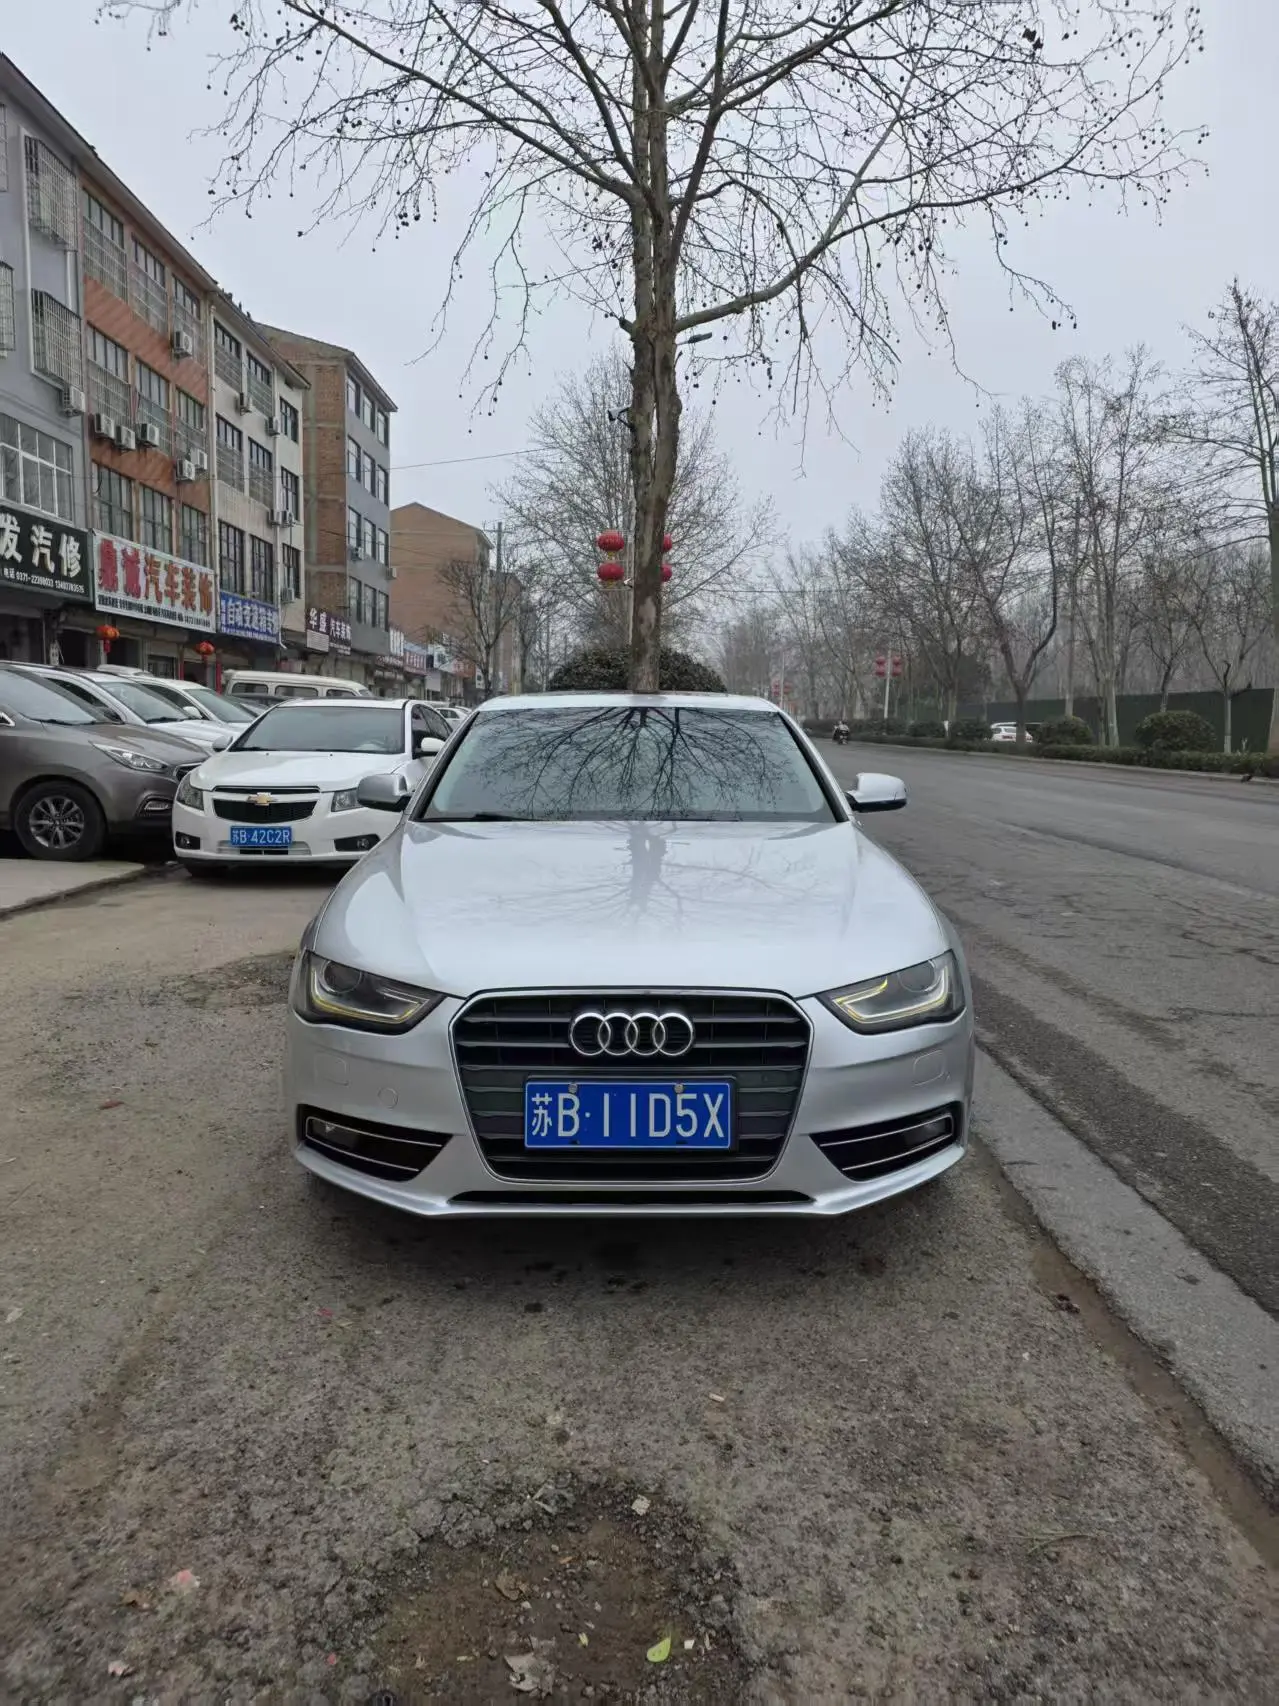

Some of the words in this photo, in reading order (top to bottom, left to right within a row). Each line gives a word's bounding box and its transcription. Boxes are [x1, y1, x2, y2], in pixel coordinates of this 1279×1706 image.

[0, 512, 82, 578] 发汽修
[531, 1092, 725, 1138] 苏B·11D5X
